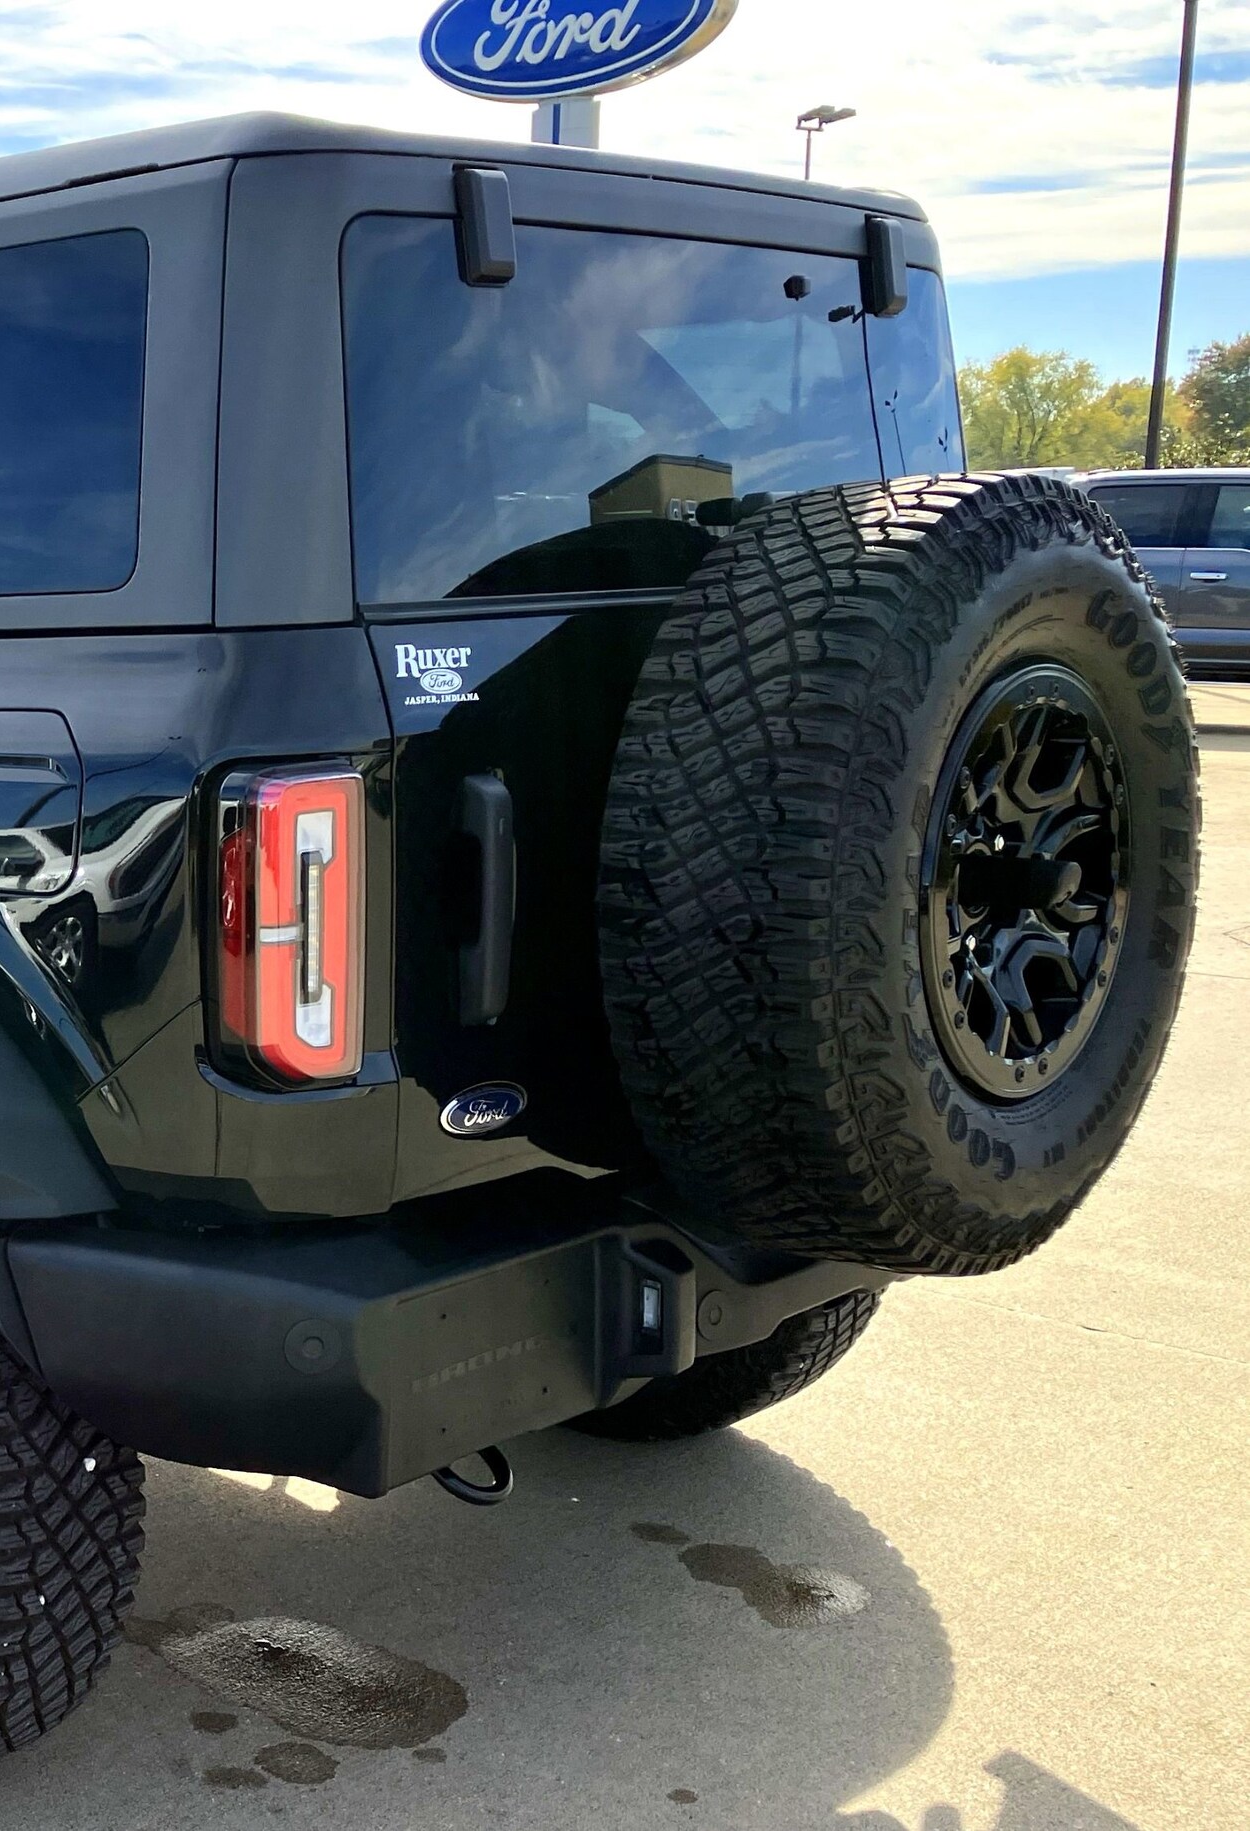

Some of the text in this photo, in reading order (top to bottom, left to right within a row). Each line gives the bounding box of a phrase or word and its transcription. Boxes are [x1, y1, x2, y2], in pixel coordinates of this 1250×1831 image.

[474, 0, 642, 71] Ford
[394, 643, 472, 678] Ruxer
[427, 674, 456, 688] Ford
[404, 692, 480, 705] JASPER, INDIANA
[463, 1099, 512, 1127] Ford
